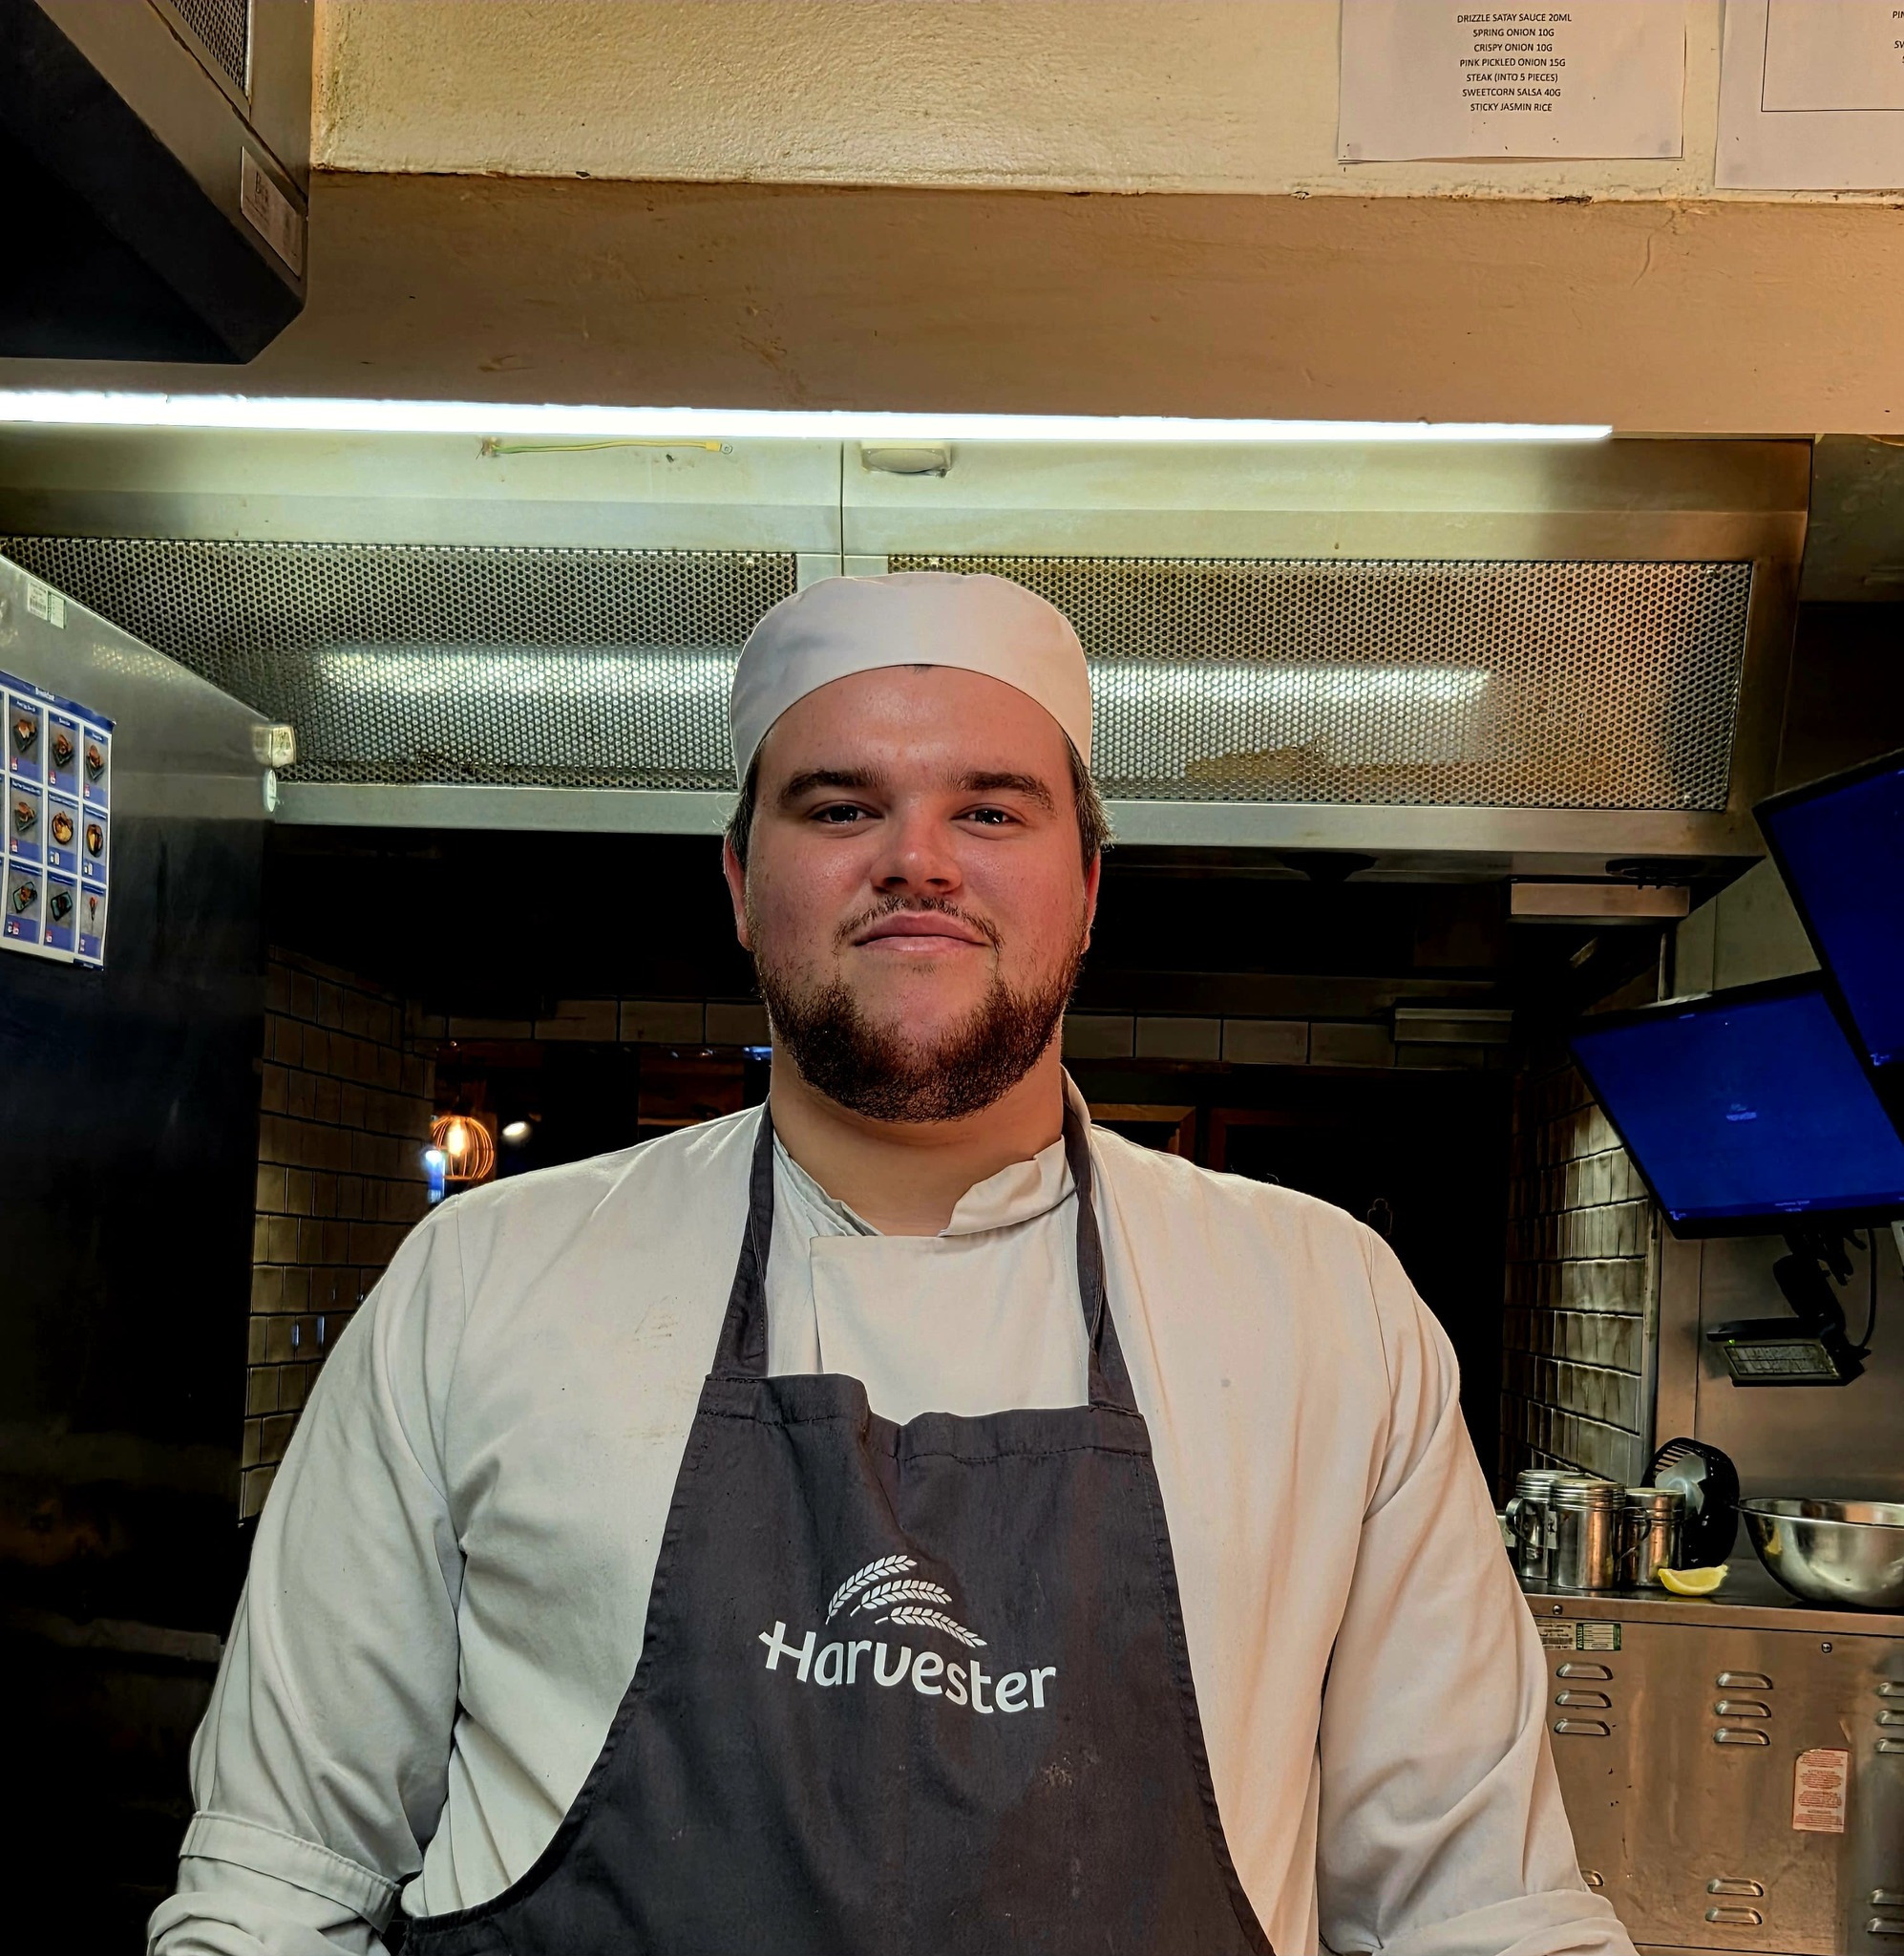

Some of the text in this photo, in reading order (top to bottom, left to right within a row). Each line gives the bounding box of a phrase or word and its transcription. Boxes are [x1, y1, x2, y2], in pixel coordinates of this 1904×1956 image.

[1457, 13, 1572, 23] DRIZZLE SATAY SAUCE 20ML
[1473, 29, 1504, 37] SPRING
[1505, 43, 1534, 52] ONION
[1550, 58, 1565, 67] 15G
[1494, 74, 1518, 82] (INTO
[1528, 74, 1557, 83] PIECES)
[1463, 88, 1514, 96] SWEETCORN
[1534, 103, 1552, 112] RICE
[759, 1621, 1056, 1714] Harvester
